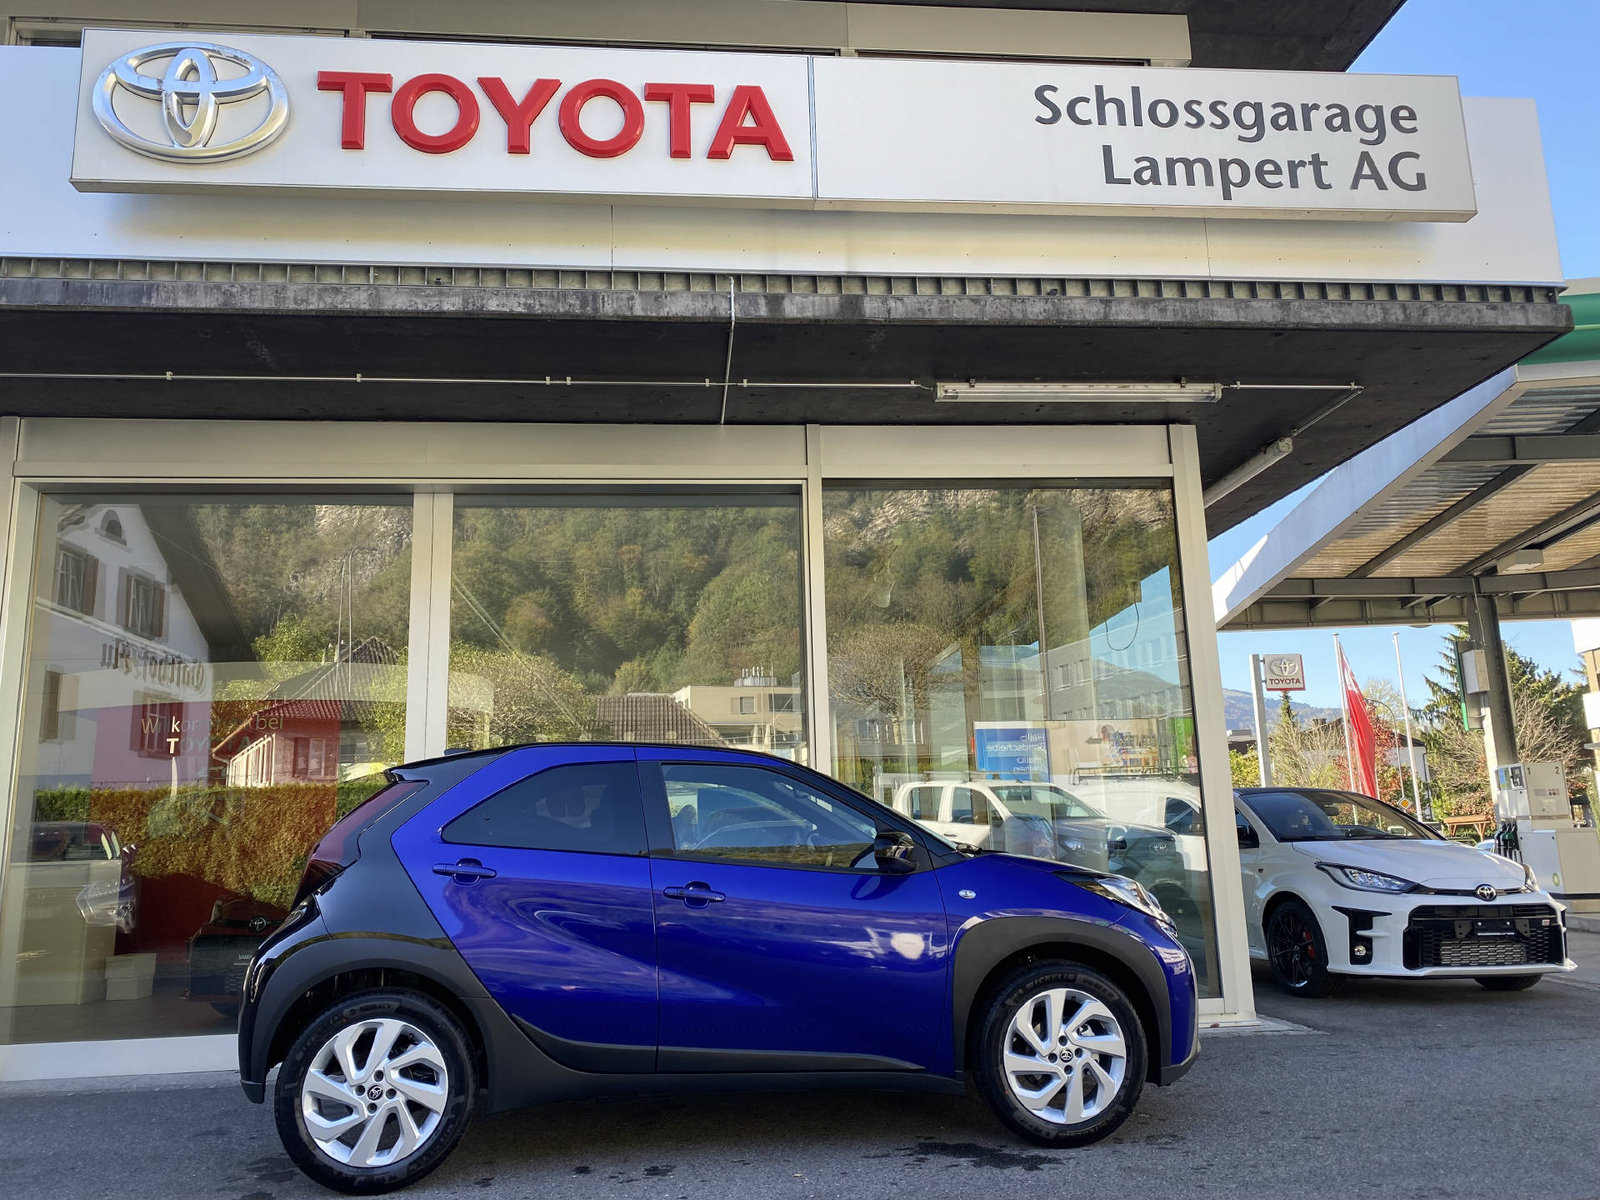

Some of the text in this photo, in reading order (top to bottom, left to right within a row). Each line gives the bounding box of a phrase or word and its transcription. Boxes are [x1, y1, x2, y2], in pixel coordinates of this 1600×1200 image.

[317, 70, 795, 162] TOYOTA
[1034, 84, 1419, 146] Schlossgarage
[1102, 144, 1427, 201] Lampert AG
[166, 736, 252, 754] TOYTA
[1555, 766, 1560, 774] 2
